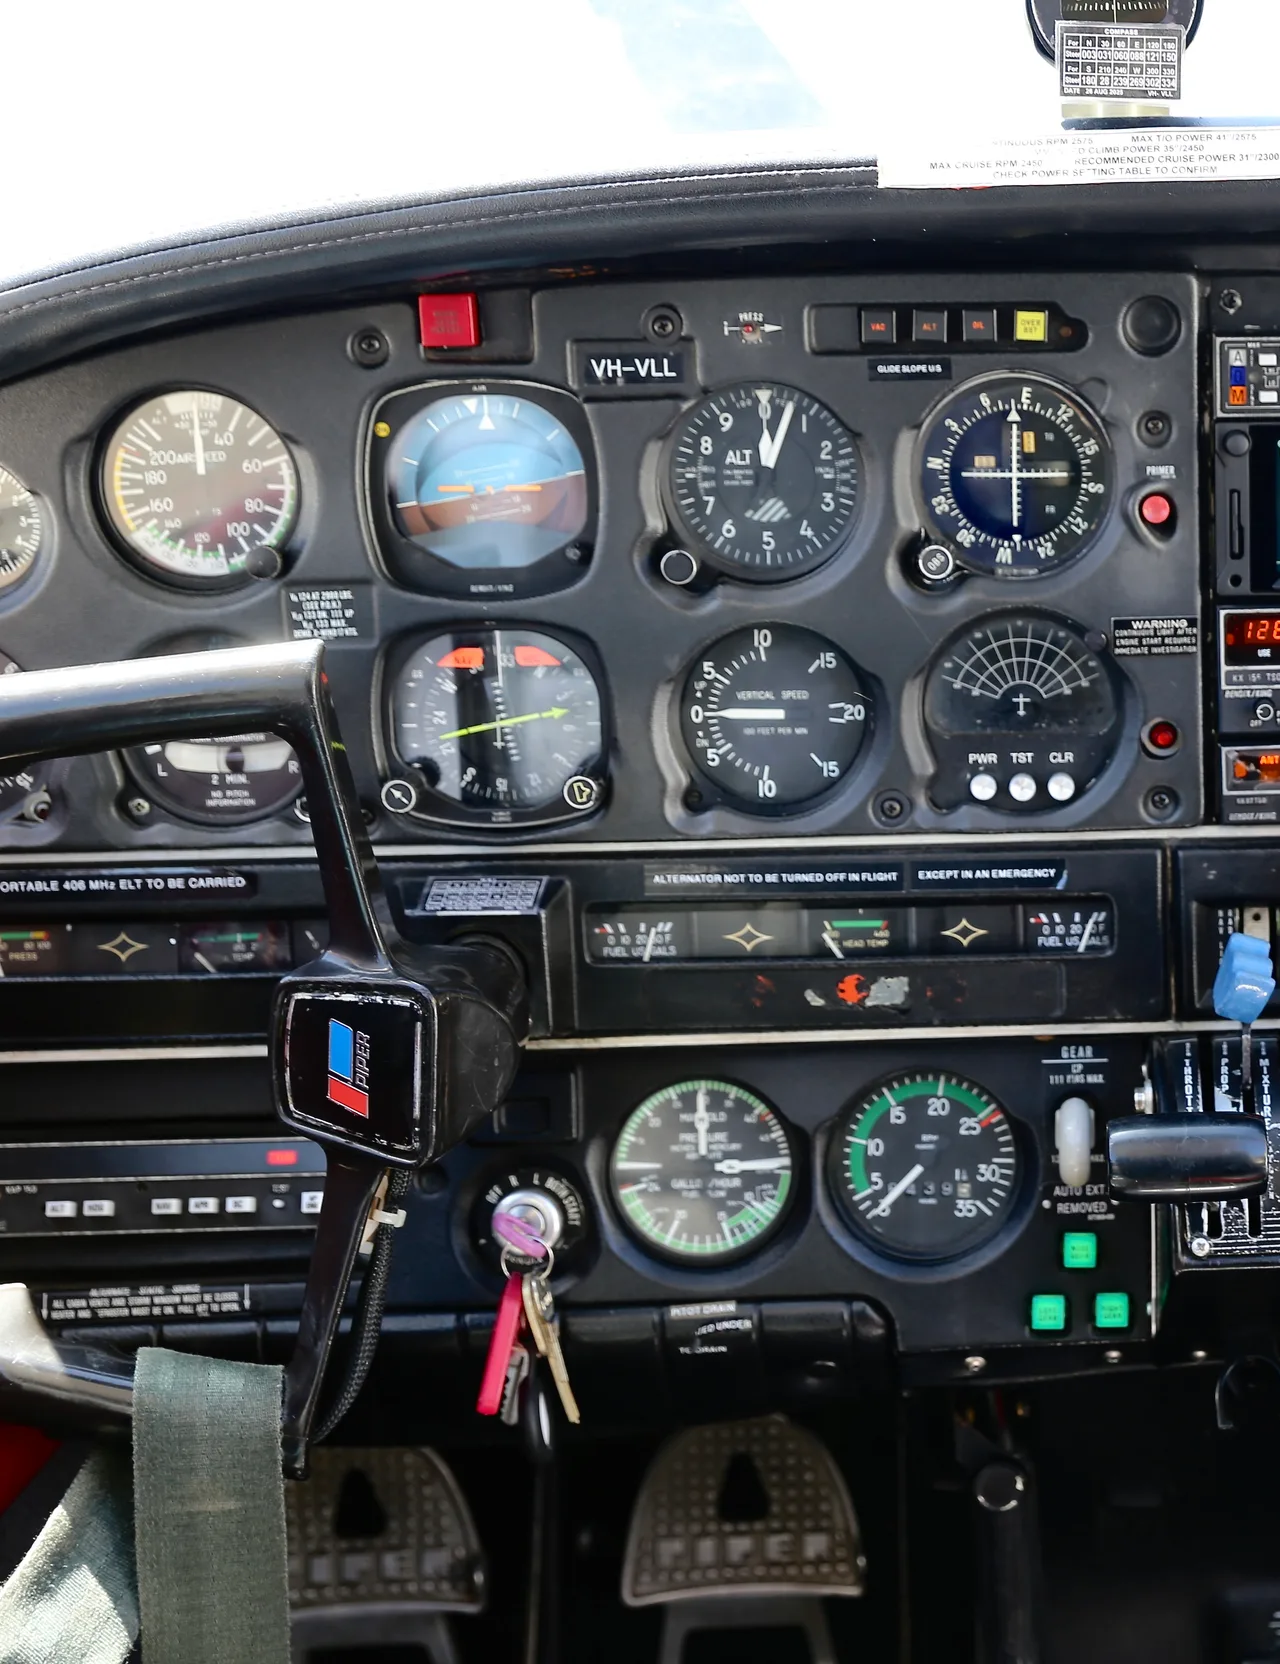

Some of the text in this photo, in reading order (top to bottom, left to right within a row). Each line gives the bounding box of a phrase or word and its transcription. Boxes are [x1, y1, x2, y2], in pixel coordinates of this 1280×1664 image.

[1104, 28, 1139, 36] COMPASS
[1065, 49, 1080, 59] Steer
[1081, 50, 1096, 59] 003
[1097, 50, 1112, 59] 031
[1113, 51, 1128, 60] 060
[1145, 51, 1160, 61] 121
[1161, 52, 1176, 62] 150
[1065, 76, 1080, 85] Steer
[1081, 77, 1096, 86] 180
[1113, 78, 1128, 87] 239
[1129, 78, 1144, 87] 269
[1145, 78, 1160, 87] 302
[1161, 79, 1176, 88] 334
[1131, 135, 1154, 143] MAX
[1156, 134, 1173, 143] T/O
[1175, 133, 1213, 143] POWER
[1088, 146, 1120, 155] CLIMB
[1123, 145, 1160, 154] POWER
[929, 159, 1043, 170] MAX CRUISE RPM 2450
[1074, 155, 1155, 165] RECOMMENDED
[1157, 154, 1195, 163] CRUISE
[1198, 153, 1236, 163] POWER
[993, 170, 1028, 179] CHECK
[1032, 169, 1069, 178] POWER
[1119, 167, 1151, 176] TABLE
[1154, 166, 1169, 175] TO
[1171, 165, 1218, 175] CONFIRM
[591, 358, 677, 379] VH-VLL
[719, 412, 734, 432] 9
[214, 432, 234, 447] 40
[700, 435, 713, 455] 8
[149, 450, 176, 466] 200
[724, 450, 752, 465] ALT
[820, 440, 833, 460] 2
[242, 459, 262, 474] 60
[1146, 465, 1176, 476] PRIMER
[144, 471, 167, 486] 180
[149, 498, 174, 513] 160
[244, 498, 264, 513] 80
[702, 496, 716, 516] 7
[820, 492, 835, 512] 3
[226, 522, 250, 537] 100
[722, 518, 736, 538] 6
[800, 519, 814, 539] 4
[762, 531, 775, 551] 5
[927, 553, 946, 572] OBS
[1131, 618, 1189, 630] WARNING
[753, 629, 772, 648] 10
[1115, 636, 1196, 647] ENGINE START REQUIRES
[1113, 646, 1149, 655] IMMEDIATE
[1257, 648, 1272, 658] USE
[819, 652, 837, 669] 15
[702, 661, 716, 680] 5
[735, 690, 810, 701] VERTICAL SPEED
[843, 704, 866, 721] 20
[706, 748, 721, 767] 5
[968, 752, 1074, 765] PWR TST CLR
[1260, 755, 1280, 766] ANT
[822, 761, 840, 778] 15
[757, 779, 777, 798] 10
[653, 871, 899, 884] ALTERNATOR NOT TO BE TURNED OFF IN FLIGHT
[918, 868, 1057, 881] EXCEPT IN AN EMERGENCY
[62, 879, 86, 892] 406
[88, 879, 117, 891] MHz
[119, 878, 142, 890] ELT
[146, 878, 164, 890] TO
[167, 877, 185, 889] BE
[188, 876, 247, 889] CARRIED
[1060, 1045, 1094, 1059] GEAR
[354, 1030, 371, 1091] PIPER
[1220, 1058, 1230, 1093] PROP
[1260, 1058, 1272, 1131] MIXTURE
[927, 1097, 950, 1117] 20
[889, 1106, 907, 1125] 15
[958, 1116, 982, 1136] 25
[867, 1137, 885, 1157] 10
[870, 1171, 884, 1191] 5
[975, 1163, 1000, 1183] 30
[1053, 1184, 1110, 1197] AUTO EXT.
[953, 1199, 978, 1218] 35
[1056, 1201, 1108, 1215] REMOVED
